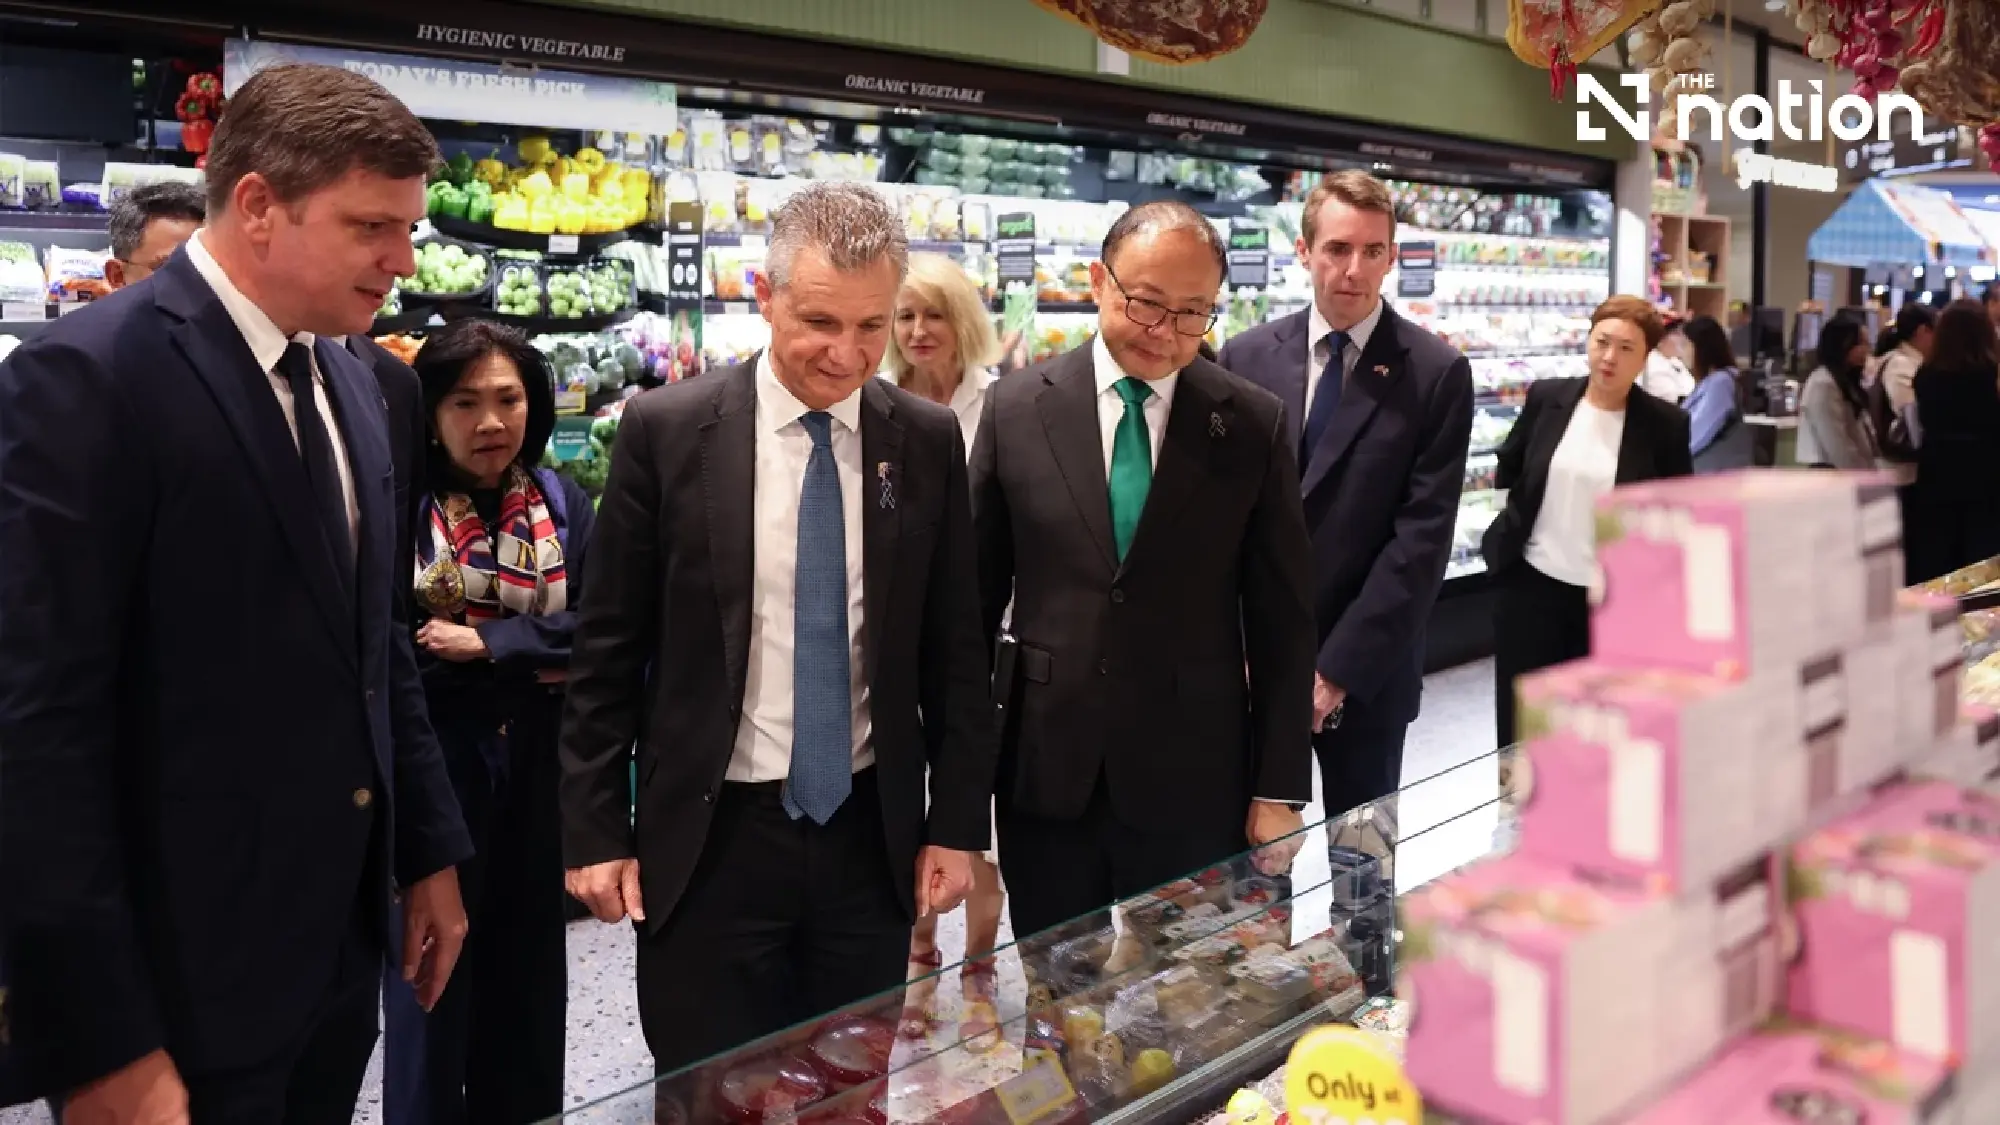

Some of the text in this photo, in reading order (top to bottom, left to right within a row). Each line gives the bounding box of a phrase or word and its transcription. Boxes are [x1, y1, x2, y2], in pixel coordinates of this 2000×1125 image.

[417, 24, 625, 62] HYGIENIC VEGETABLE
[845, 74, 985, 103] ORGANIC VEGETABLE
[1307, 1071, 1376, 1110] Only
